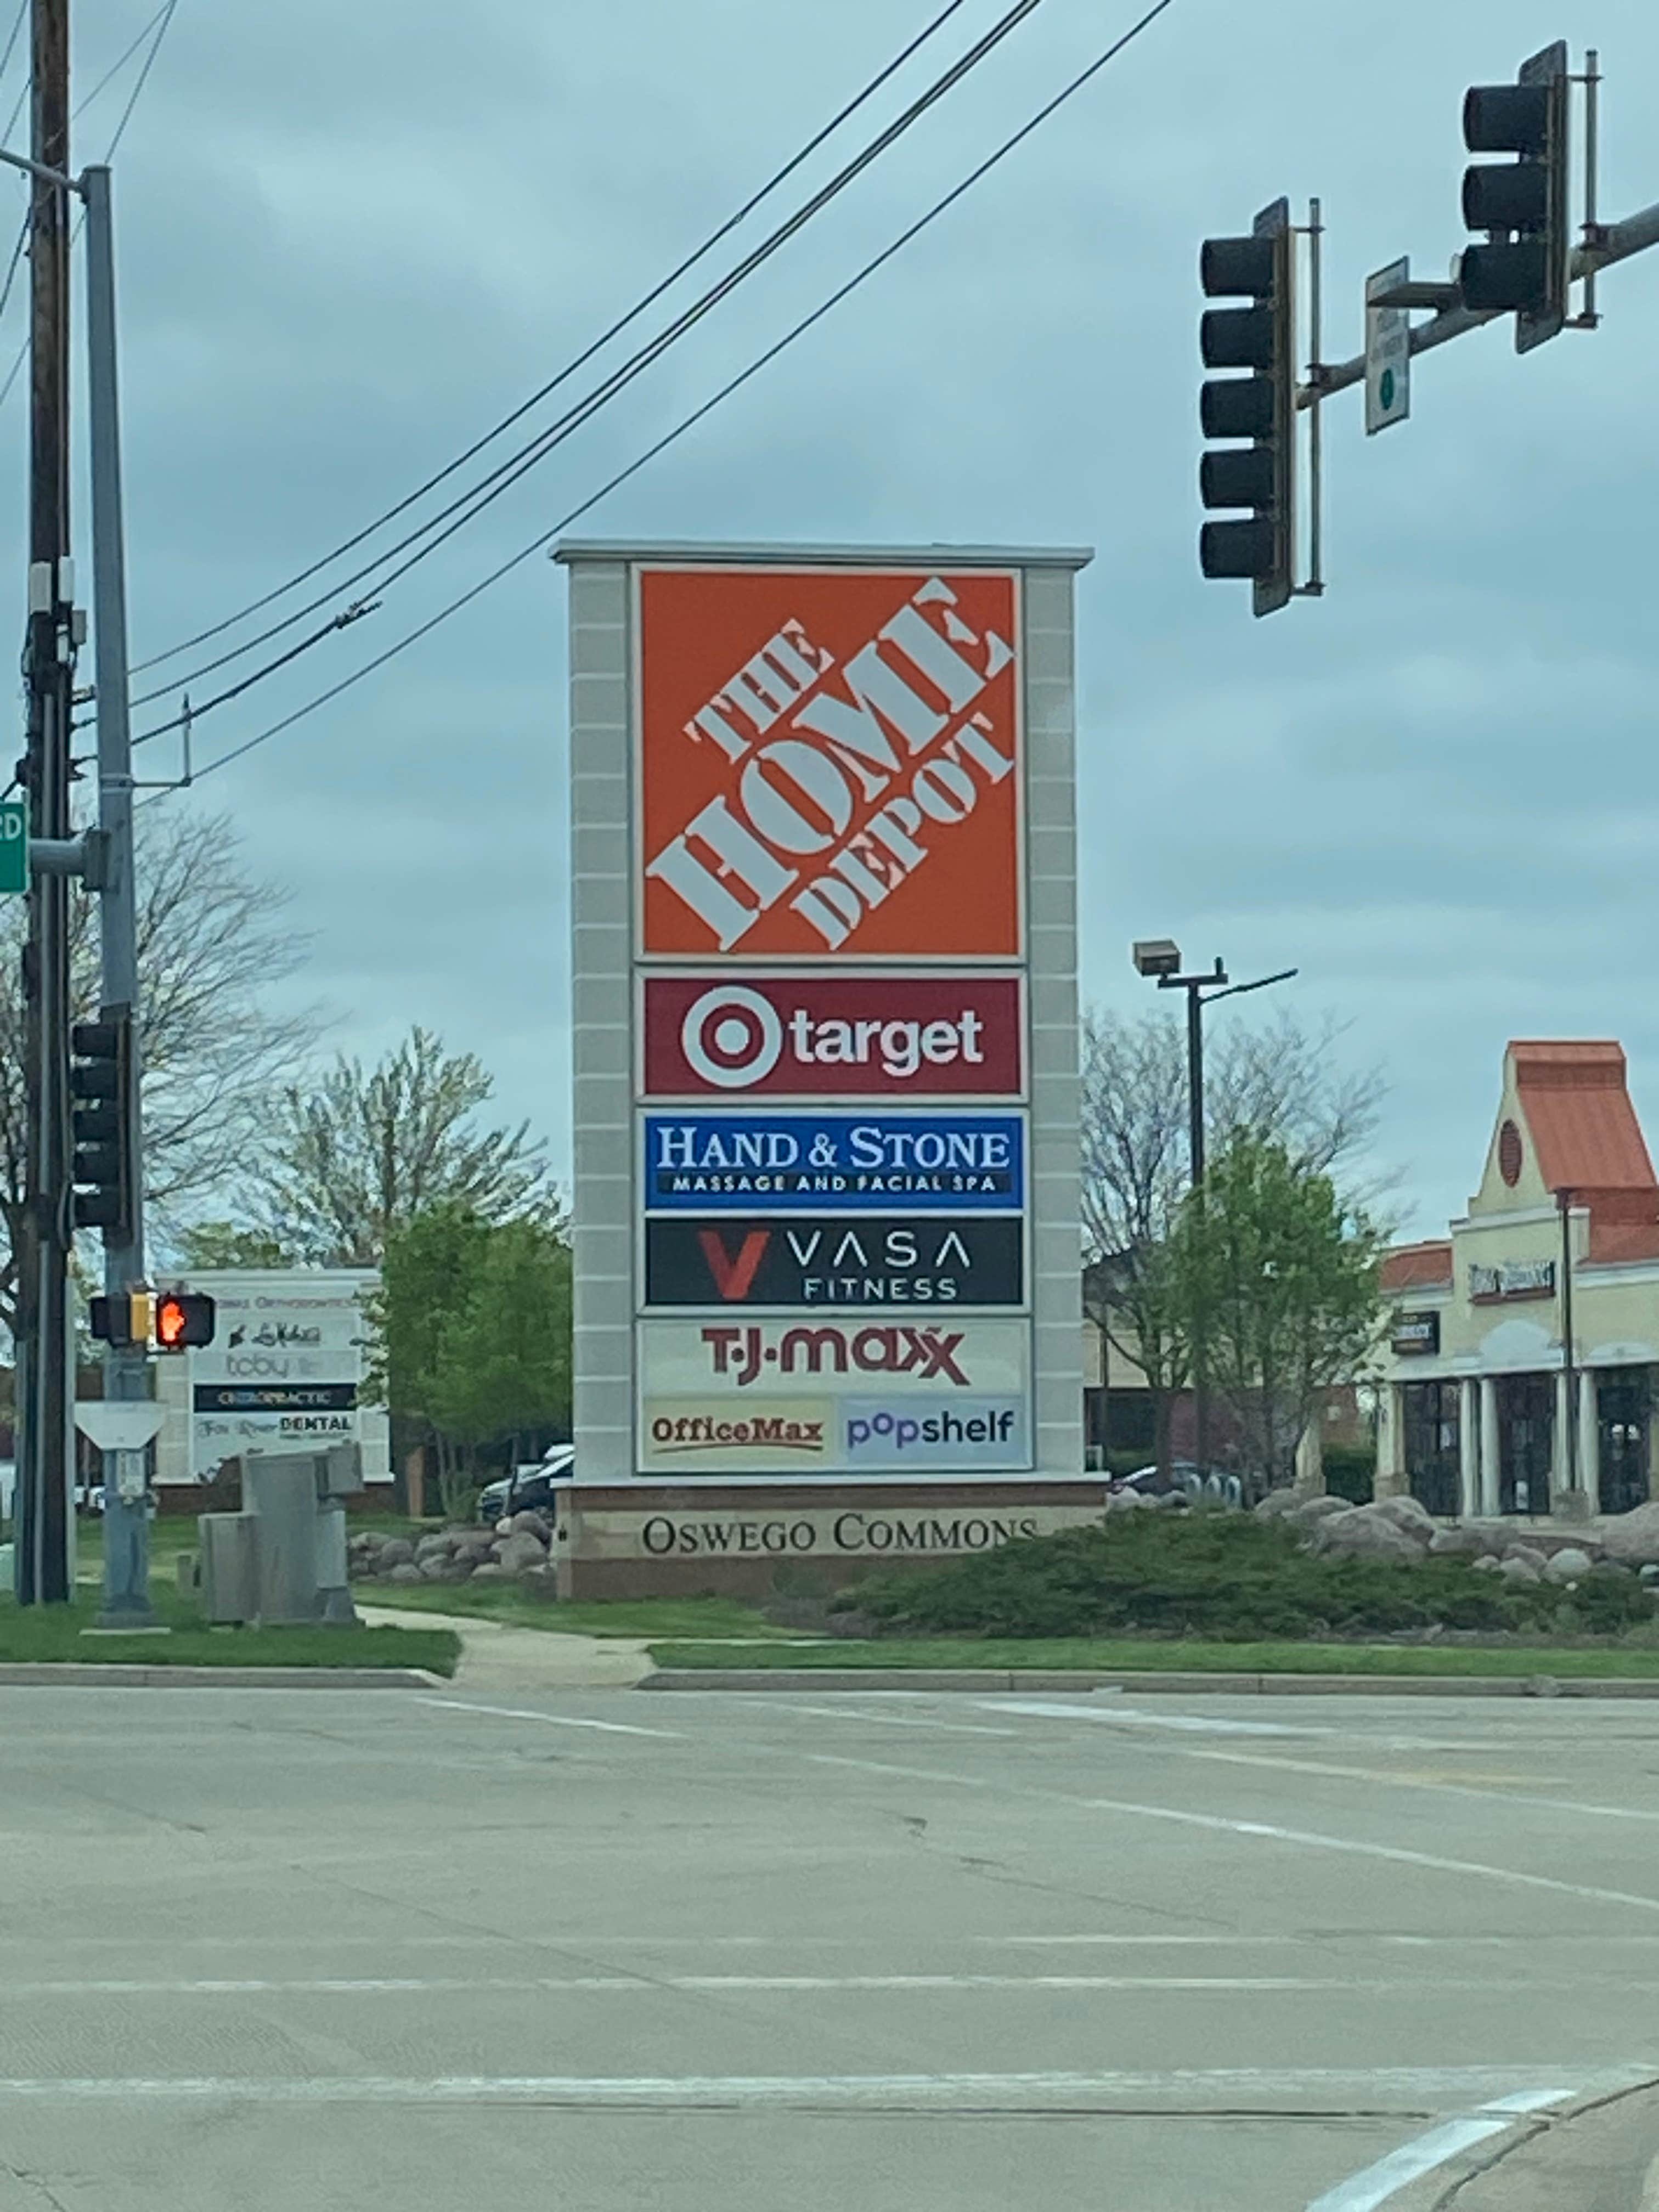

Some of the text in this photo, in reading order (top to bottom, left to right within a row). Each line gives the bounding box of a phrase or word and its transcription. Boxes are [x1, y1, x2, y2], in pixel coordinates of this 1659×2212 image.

[682, 618, 835, 764] THE
[645, 576, 1015, 952] HOME
[0, 812, 21, 840] D
[789, 712, 1014, 951] DEPOT
[789, 1010, 984, 1077] target
[657, 1126, 1011, 1168] HAND & STONE
[673, 1175, 996, 1192] MASSAGE AND FACIAL SPA
[804, 1278, 958, 1300] FITNESS
[279, 1417, 352, 1431] DENTAL
[652, 1415, 823, 1443] OfficeMax
[847, 1410, 1014, 1449] popshelf
[642, 1516, 817, 1555] OSWEGO
